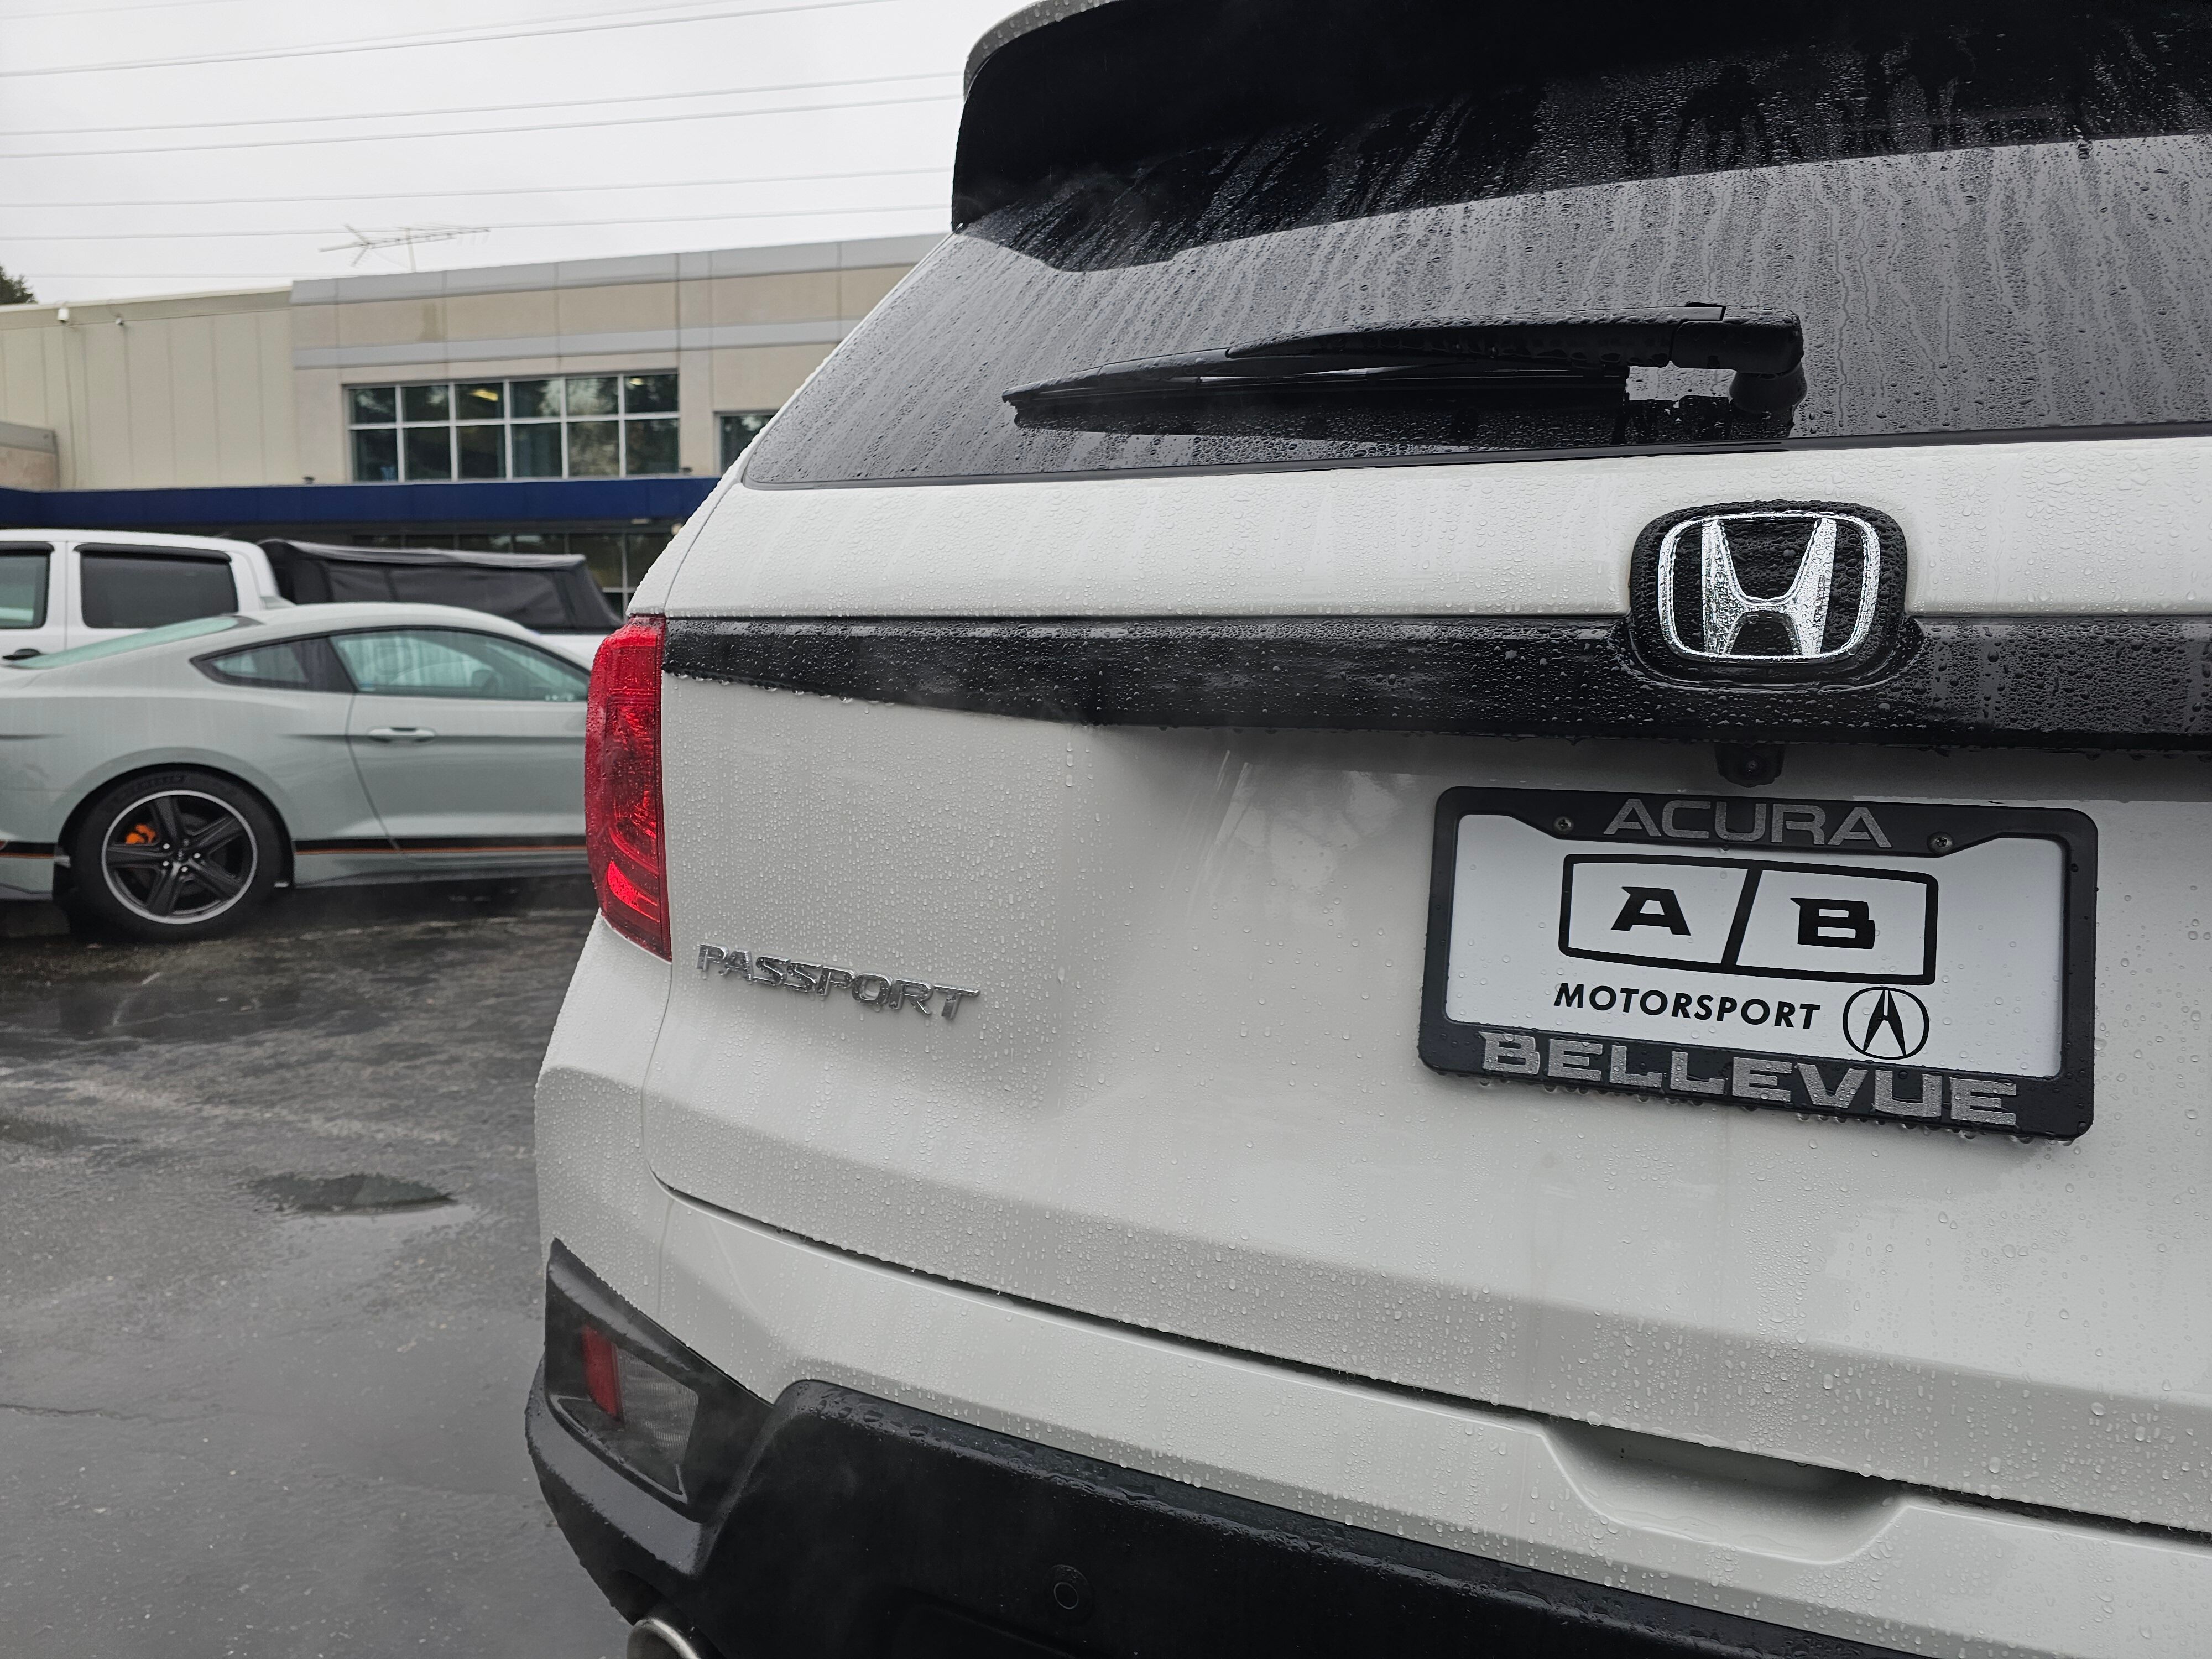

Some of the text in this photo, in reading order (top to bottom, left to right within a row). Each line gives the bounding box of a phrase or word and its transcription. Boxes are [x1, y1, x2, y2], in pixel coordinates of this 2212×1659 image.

[1603, 797, 1892, 848] ACURA
[1610, 886, 1875, 949] A B
[697, 944, 981, 1019] PASSPORT
[1553, 982, 1820, 1030] MOTORSPORT
[1480, 1031, 2017, 1125] BELLEVUE
